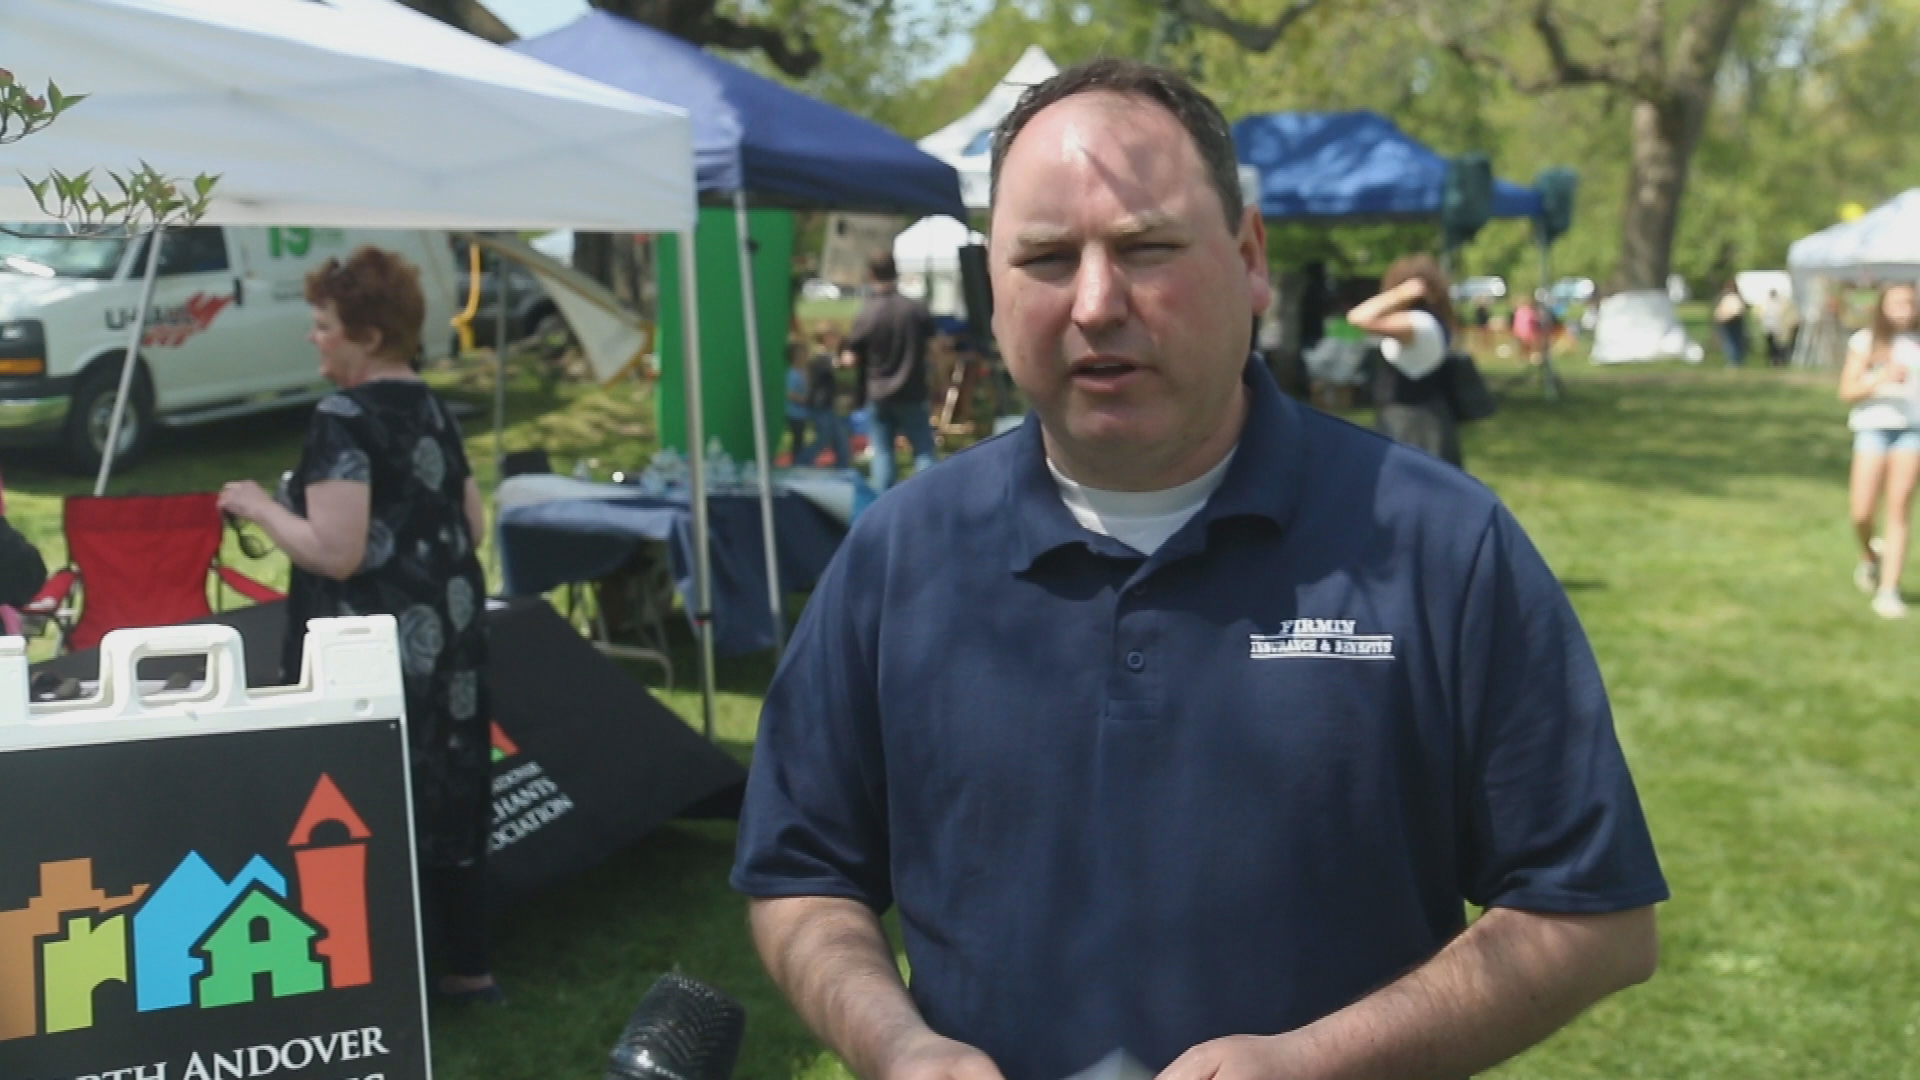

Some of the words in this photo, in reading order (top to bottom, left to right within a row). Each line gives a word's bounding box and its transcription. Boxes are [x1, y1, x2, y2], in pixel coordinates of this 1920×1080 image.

[1281, 618, 1355, 634] FIRMIN
[1320, 639, 1331, 651] &
[183, 1026, 390, 1080] ANDOVER
